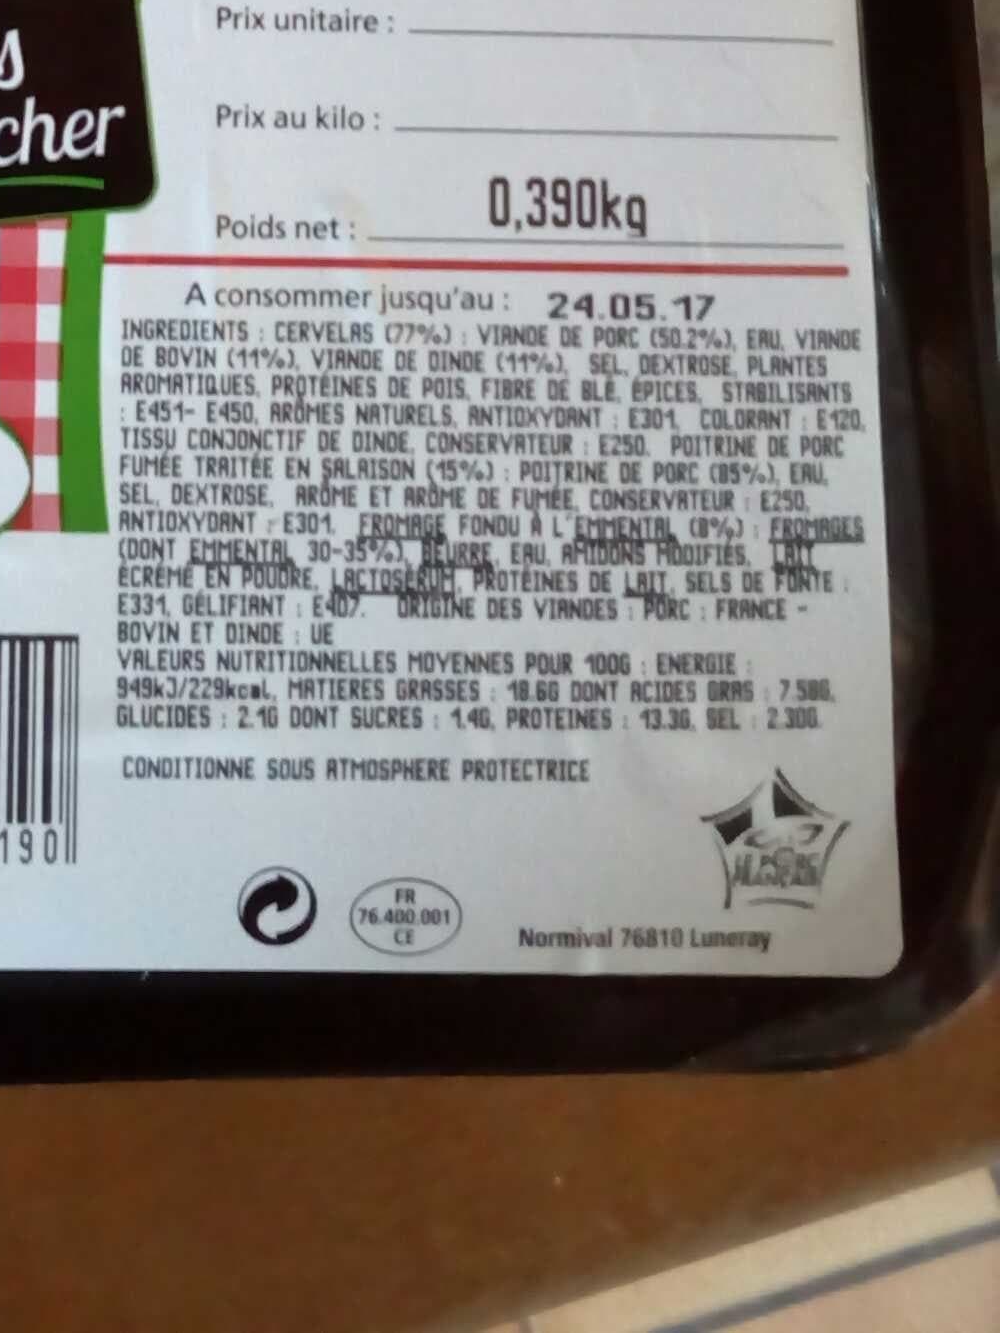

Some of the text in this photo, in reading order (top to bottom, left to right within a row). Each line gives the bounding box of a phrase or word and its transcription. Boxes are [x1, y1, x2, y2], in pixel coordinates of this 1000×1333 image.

[215, 7, 379, 34] Prix unitaire
[215, 104, 366, 131] Prix au kilo
[215, 177, 648, 241] Poids net 0,390kg
[183, 283, 716, 321] A consommer jusqu'au 24.05.17
[121, 319, 250, 343] INGREDIENTS
[274, 321, 374, 345] CERVELAS
[384, 322, 452, 346] (77%)
[476, 323, 549, 347] VIANDE
[559, 324, 583, 348] DE
[592, 325, 640, 348] PORC
[794, 328, 861, 351] VIANDE
[120, 347, 145, 369] DE
[154, 347, 217, 370] BOVIN
[310, 349, 384, 372] VIANDE
[394, 350, 418, 372] DE
[427, 350, 486, 373] DINDE
[746, 354, 828, 377] PLANTES
[387, 377, 411, 399] DE
[480, 378, 536, 400] FIBRE
[546, 379, 571, 400] DE
[721, 381, 853, 403] STABILISANTS
[467, 405, 603, 429] ANTIOXYDANT
[699, 408, 792, 431] COLORANT
[121, 430, 177, 452] TISSU
[186, 430, 306, 453] CONJONCTIF
[317, 431, 341, 454] DE
[425, 432, 574, 456] CONSERVATEUR
[669, 435, 757, 458] POITRINE
[767, 436, 790, 458] DE
[799, 436, 845, 458] PORC
[119, 453, 183, 479] FUMÉE
[195, 453, 274, 480] TRAITÉE
[284, 458, 311, 481] EN
[320, 458, 416, 482] SALAISON
[425, 460, 495, 483] (15%)
[519, 460, 609, 484] POITRINE
[618, 461, 643, 484] DE
[652, 462, 699, 485] PORC
[368, 487, 392, 509] ET
[476, 488, 501, 510] DE
[589, 488, 735, 511] CONSERVATEUR
[118, 512, 521, 536] ANTIOXYDANT FROMAGE FONDU
[204, 569, 231, 590] EN
[685, 571, 733, 592] SELS
[486, 597, 523, 618] DES
[533, 597, 619, 619] VIANDES
[642, 598, 691, 619] PORC
[715, 598, 787, 619] FRANCE
[116, 623, 334, 645] BOVIN ET DINDE UE
[116, 649, 737, 675] VALEURS NUTRITIONNELLES MOYENNES POUR 100G ENERGIE
[287, 678, 385, 701] MATIERES
[395, 678, 481, 701] GRASSES
[570, 679, 619, 702] DONT
[629, 679, 697, 702] ACIDES
[115, 706, 613, 729] GLUCIDES DONT SUCRES PROTEINES
[122, 757, 590, 781] CONDITIONNE SOUS ATMOSPHERE PROTECTRICE
[394, 888, 416, 904] FR
[393, 928, 415, 946] CE
[518, 928, 772, 952] Normival 76810 Luneray
